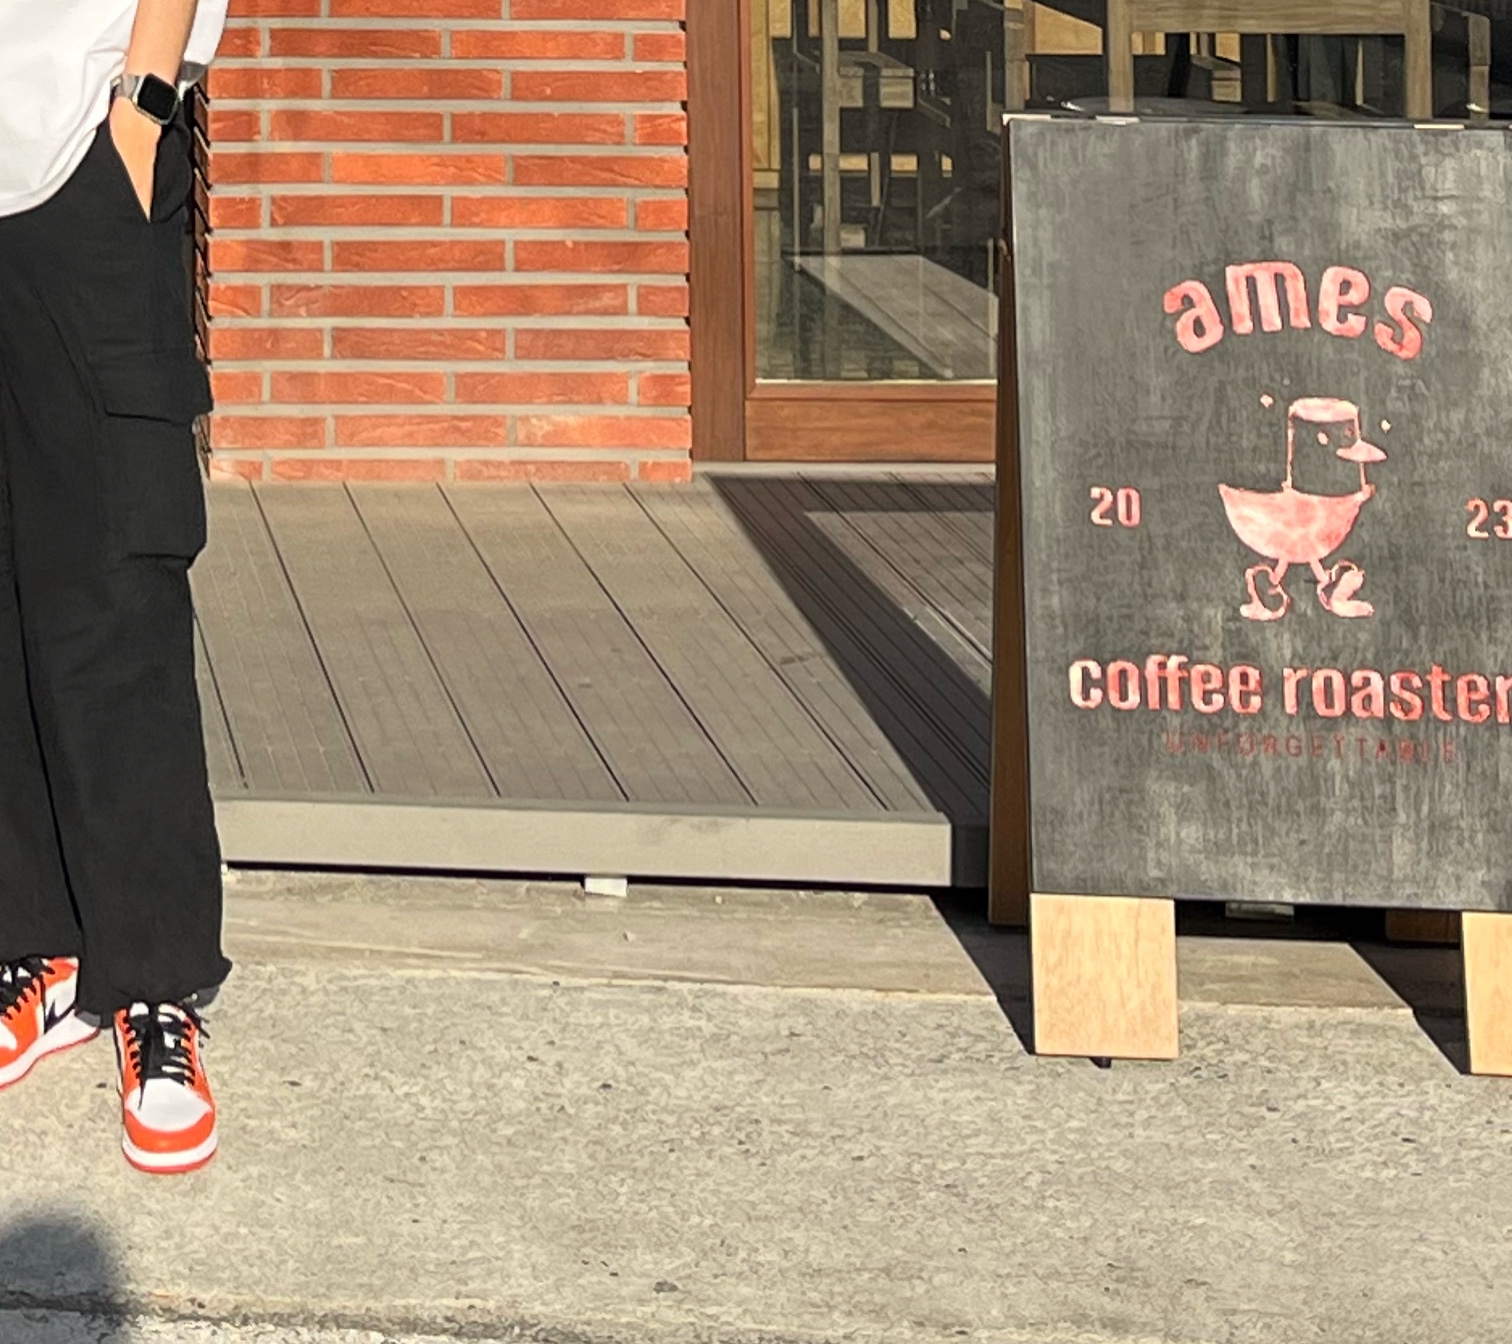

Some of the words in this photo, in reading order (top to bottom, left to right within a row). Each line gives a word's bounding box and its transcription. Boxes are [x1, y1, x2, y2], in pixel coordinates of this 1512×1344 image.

[1162, 259, 1433, 361] ames
[1090, 485, 1142, 528] 20
[1465, 496, 1512, 540] 23
[1068, 653, 1265, 717] coffee
